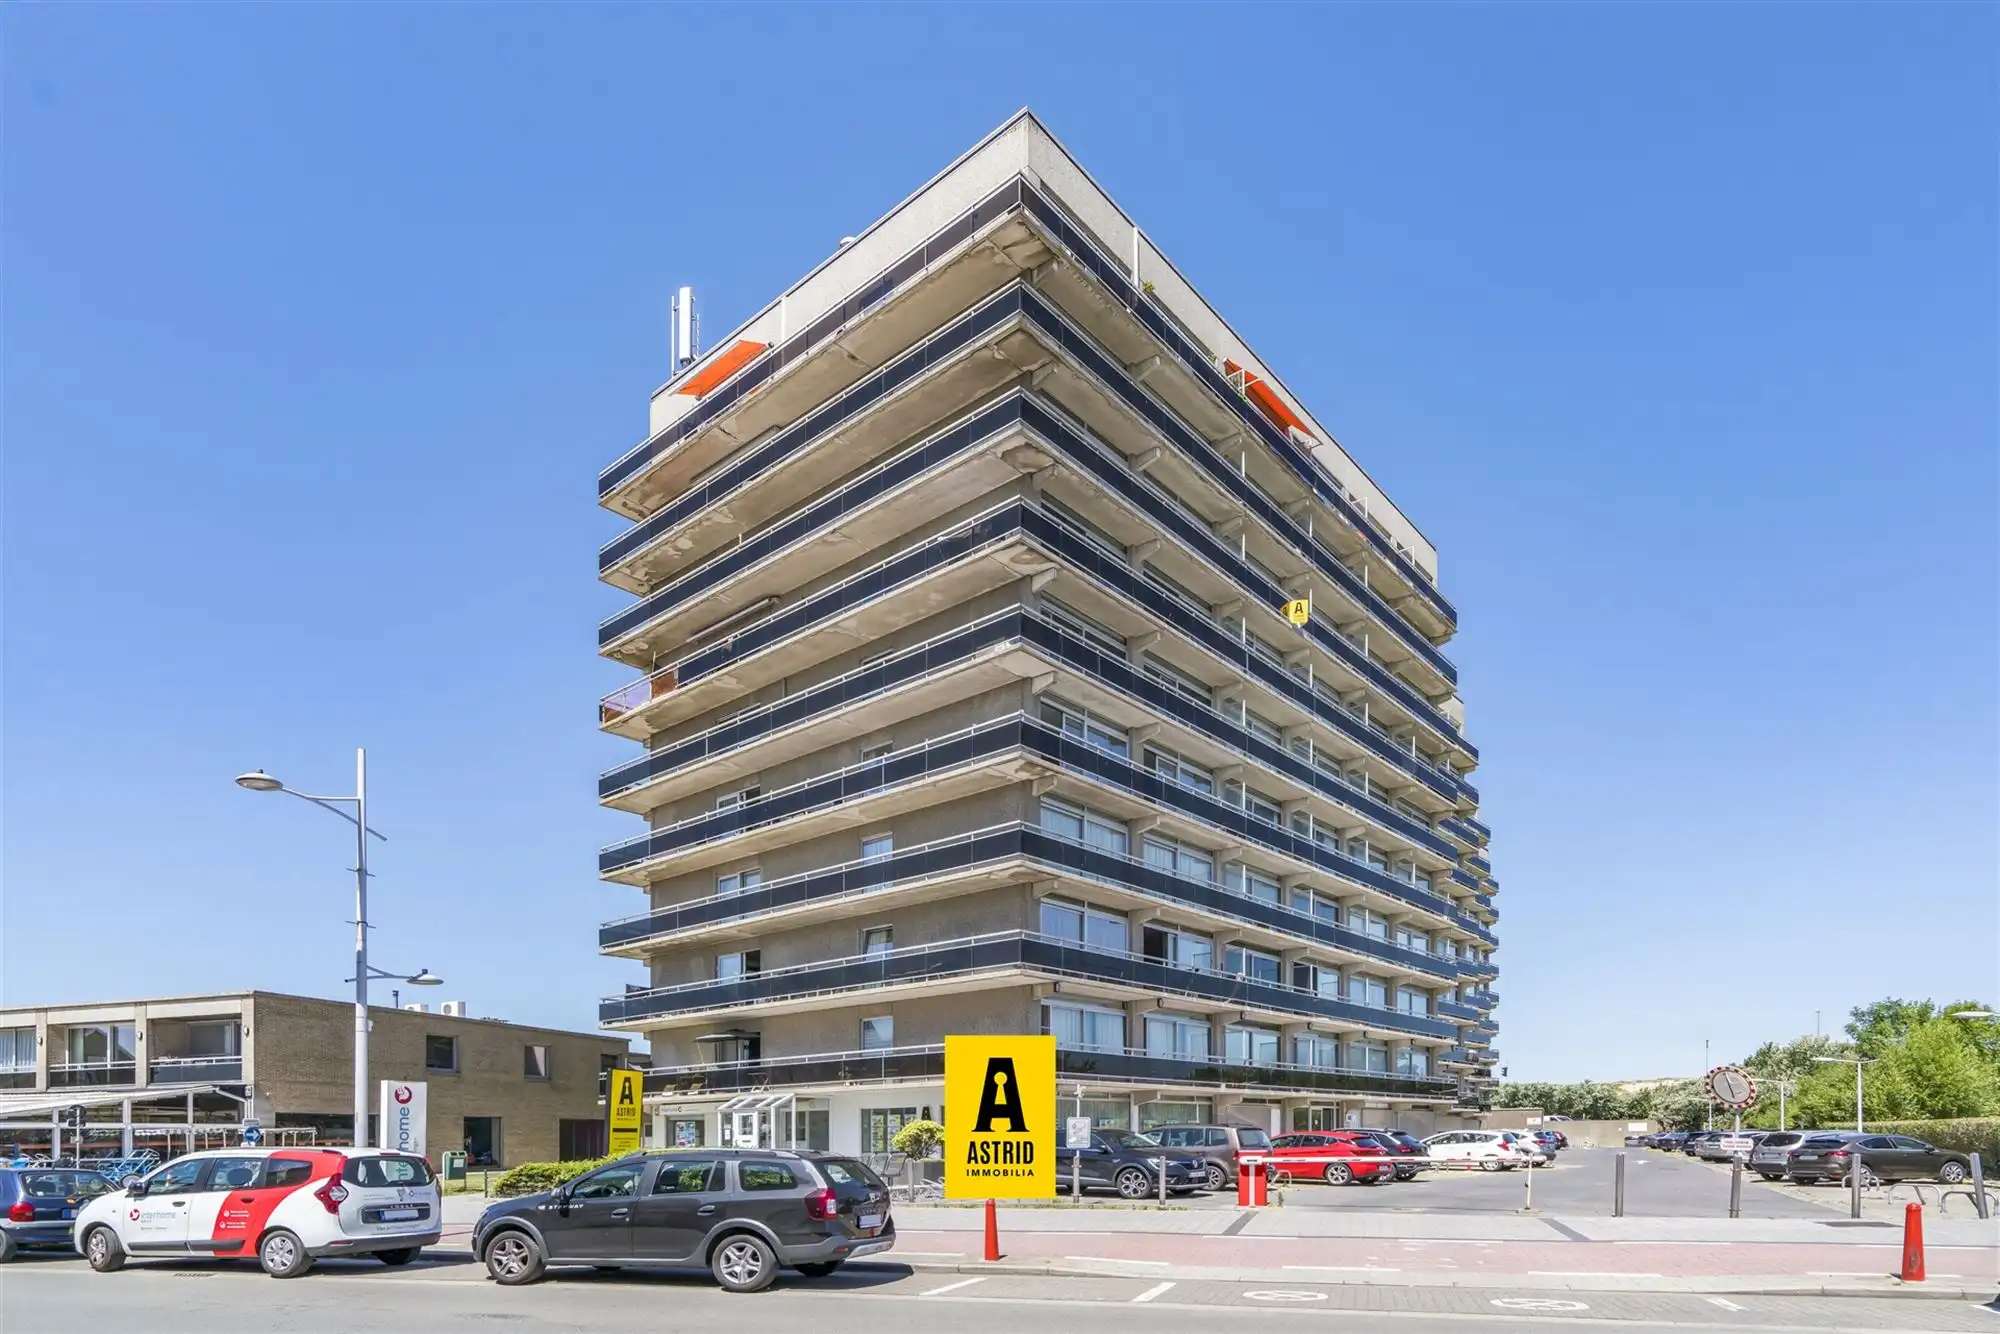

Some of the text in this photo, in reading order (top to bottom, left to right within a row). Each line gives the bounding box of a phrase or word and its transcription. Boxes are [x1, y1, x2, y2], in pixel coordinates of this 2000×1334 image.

[1294, 602, 1304, 613] A
[619, 1076, 634, 1104] A
[616, 1107, 636, 1117] ASTRID
